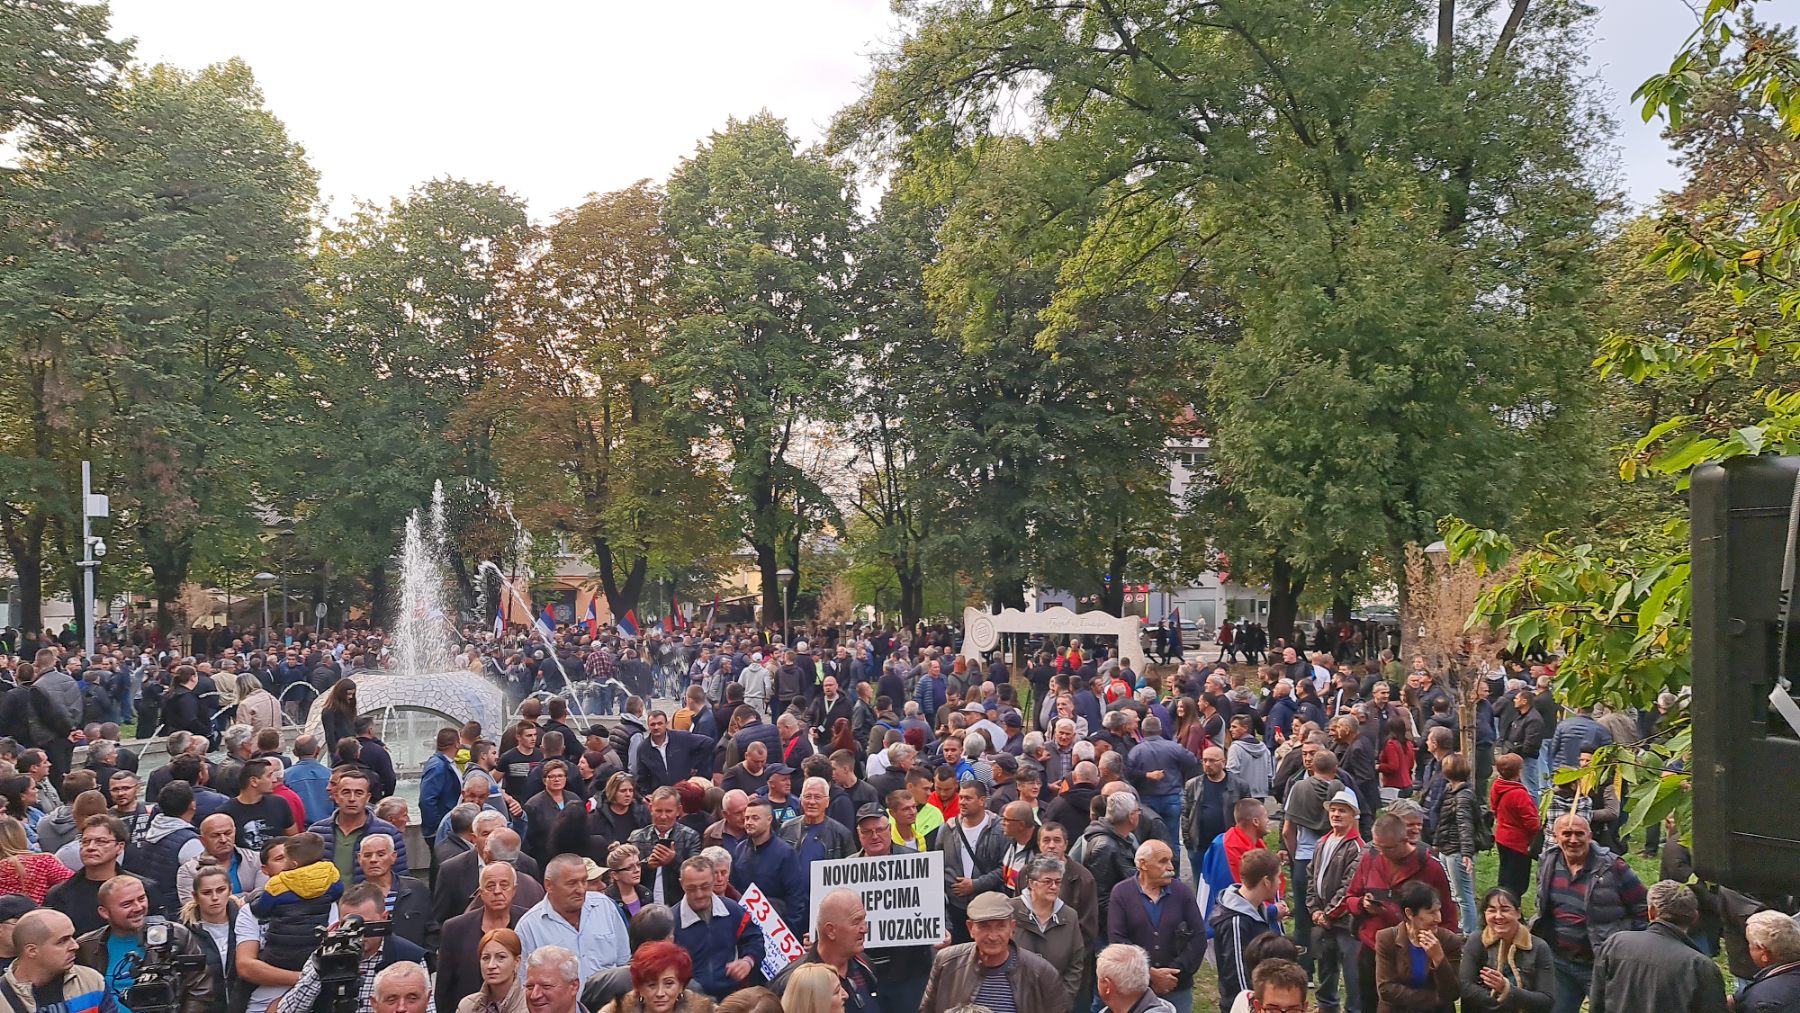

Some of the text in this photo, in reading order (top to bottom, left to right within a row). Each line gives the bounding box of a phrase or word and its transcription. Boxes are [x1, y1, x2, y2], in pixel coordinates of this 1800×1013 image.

[823, 858, 929, 886] NOVONASTALIM
[745, 889, 770, 921] 23
[879, 912, 940, 941] VOZAČKE
